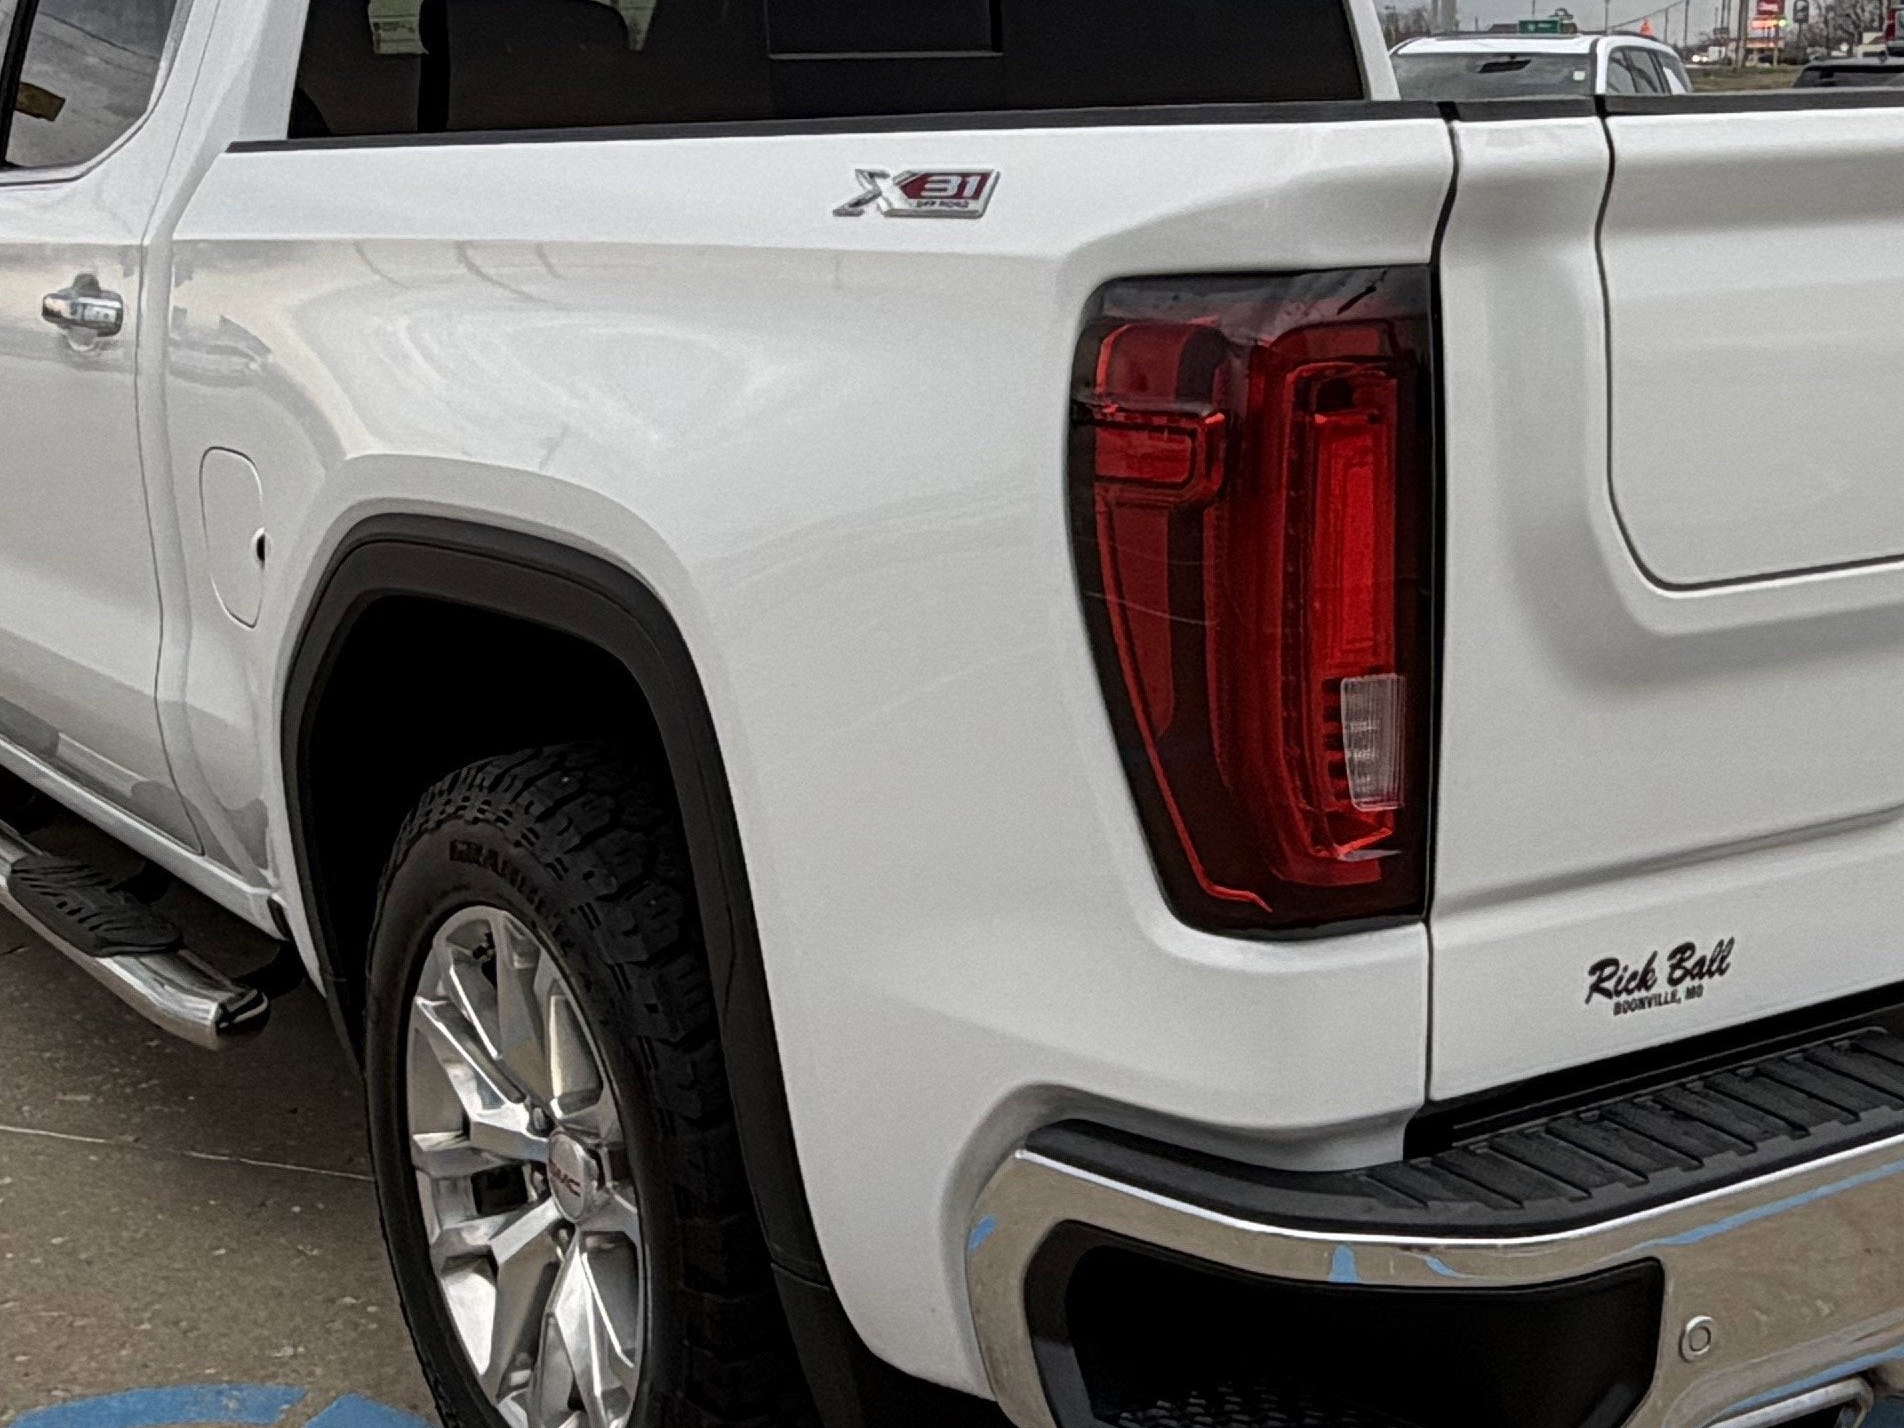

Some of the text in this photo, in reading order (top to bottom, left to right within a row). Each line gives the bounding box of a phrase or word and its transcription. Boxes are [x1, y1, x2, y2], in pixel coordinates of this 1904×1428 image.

[1584, 936, 1736, 1005] Rick Ball
[1684, 983, 1704, 1000] MO
